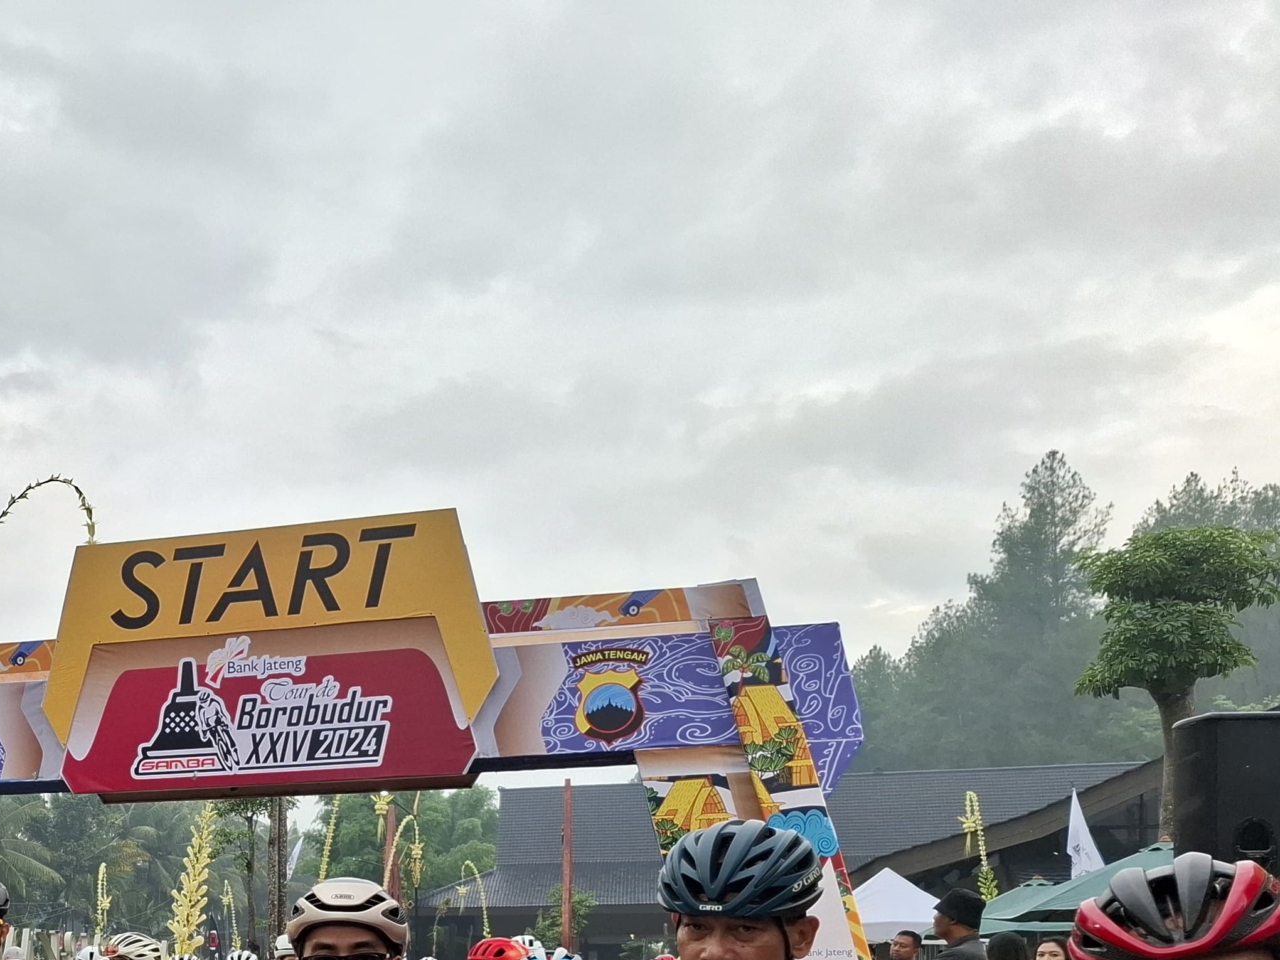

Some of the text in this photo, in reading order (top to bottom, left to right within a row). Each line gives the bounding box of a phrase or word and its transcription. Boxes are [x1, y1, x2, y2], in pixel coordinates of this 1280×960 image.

[110, 523, 417, 630] START
[227, 658, 302, 675] Bank Jateng
[575, 650, 647, 666] JAWA TENGAH
[264, 679, 337, 701] Tour de
[236, 690, 388, 730] Borobudur
[245, 728, 379, 765] XXIV 2024
[140, 757, 216, 771] SAMBA
[804, 867, 821, 886] GIRO
[808, 948, 853, 958] ank Jateng
